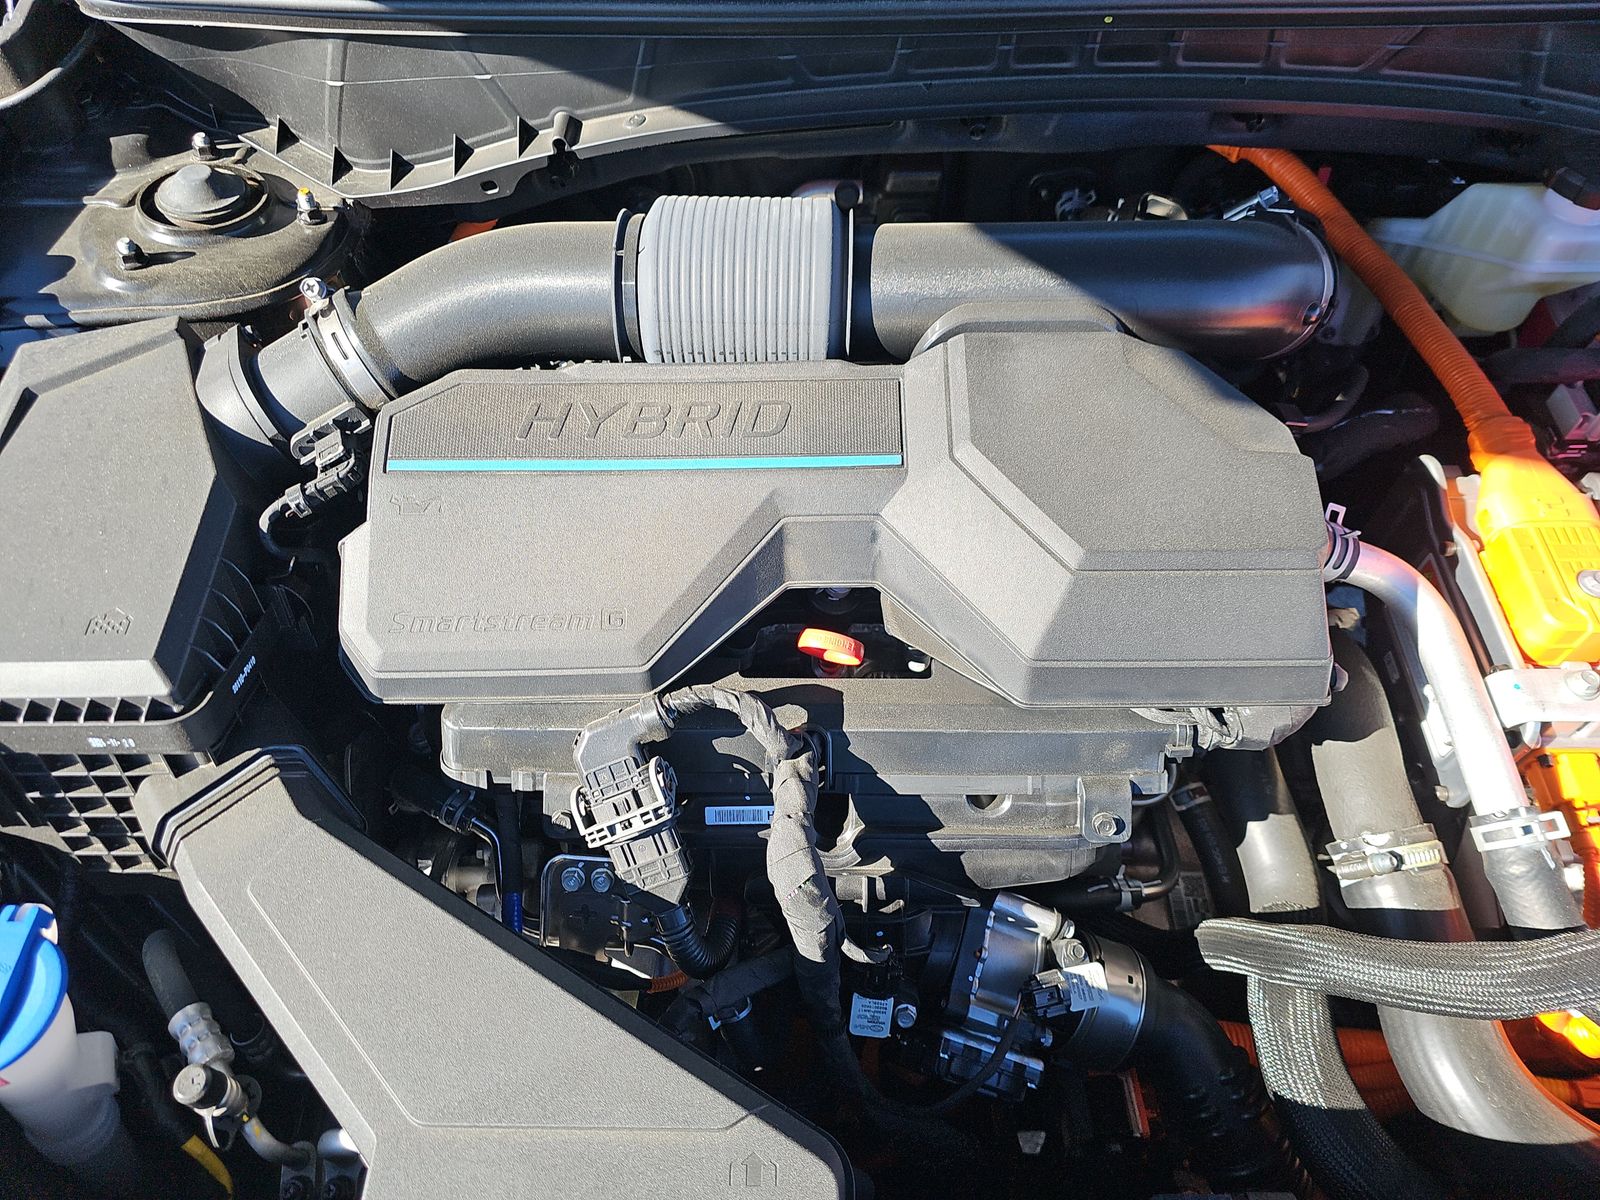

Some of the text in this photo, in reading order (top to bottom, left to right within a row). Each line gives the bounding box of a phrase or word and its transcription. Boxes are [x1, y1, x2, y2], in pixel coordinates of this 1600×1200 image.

[516, 401, 792, 440] HYBRID
[388, 608, 626, 633] Smartstream G
